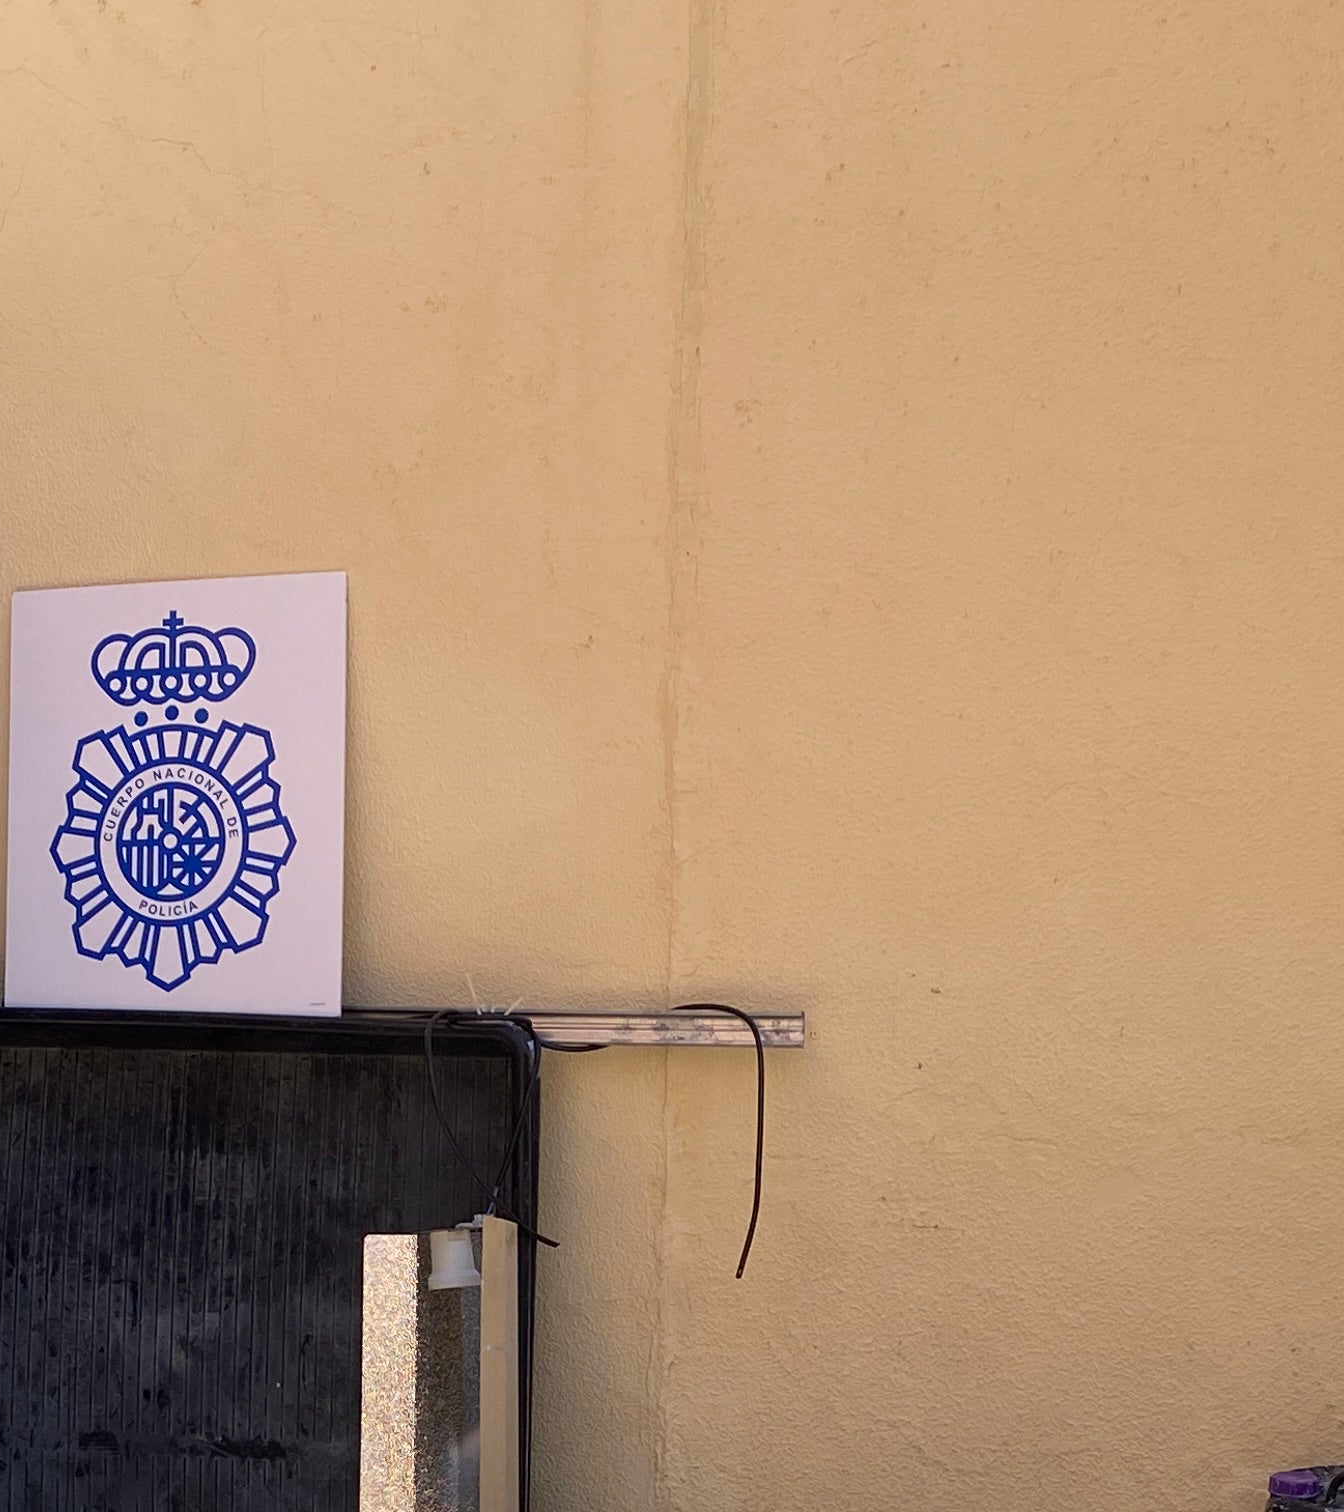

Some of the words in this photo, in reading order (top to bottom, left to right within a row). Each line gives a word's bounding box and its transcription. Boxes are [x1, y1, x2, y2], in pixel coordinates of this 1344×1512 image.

[103, 777, 145, 842] CUERPO
[152, 767, 229, 810] NACIONAL
[226, 816, 240, 839] DE
[138, 899, 199, 917] POLICÍA
